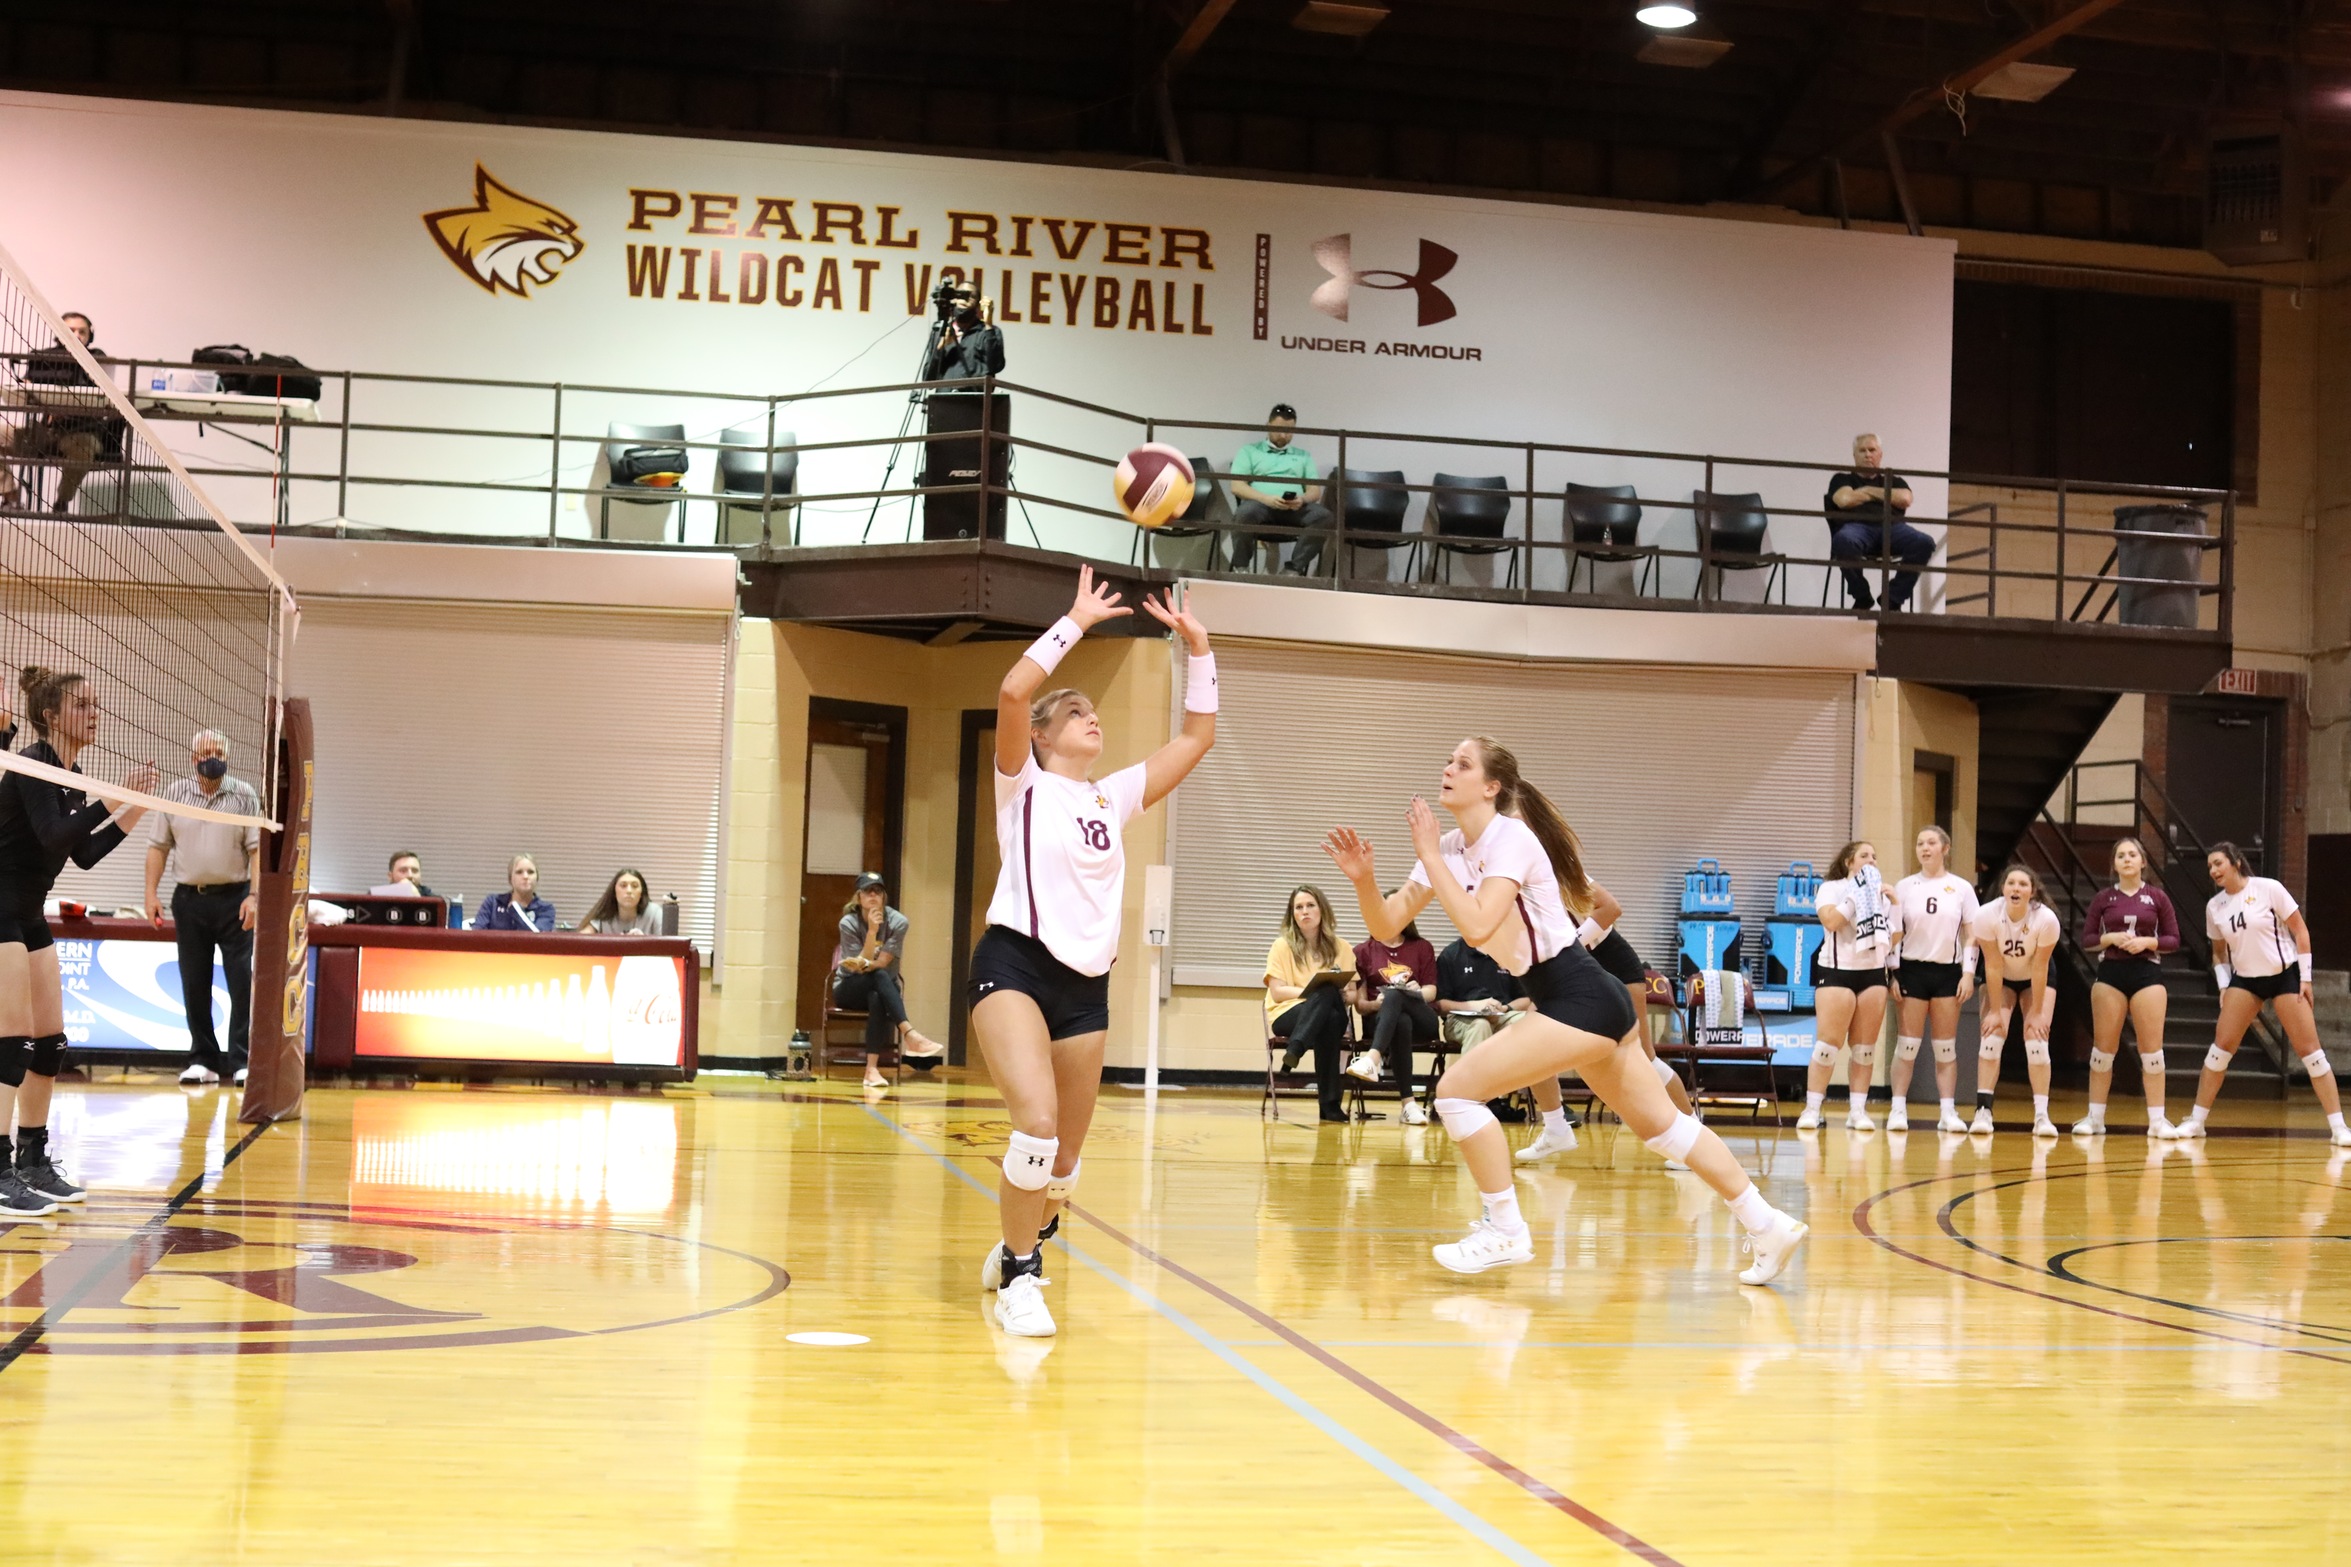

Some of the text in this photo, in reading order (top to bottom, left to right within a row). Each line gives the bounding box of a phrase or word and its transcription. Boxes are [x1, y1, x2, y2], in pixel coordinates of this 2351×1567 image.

[626, 188, 1214, 271] PEARL RIVER
[627, 243, 881, 314] WILDCAT
[1257, 237, 1267, 336] POWERED BY
[1281, 335, 1482, 362] UNDER ARMOUR
[2225, 670, 2252, 691] EXIT
[1076, 817, 1111, 851] 18
[1926, 896, 1938, 915] 6
[2123, 915, 2137, 937] 7
[2229, 911, 2248, 933] 14
[2003, 939, 2026, 957] 25
